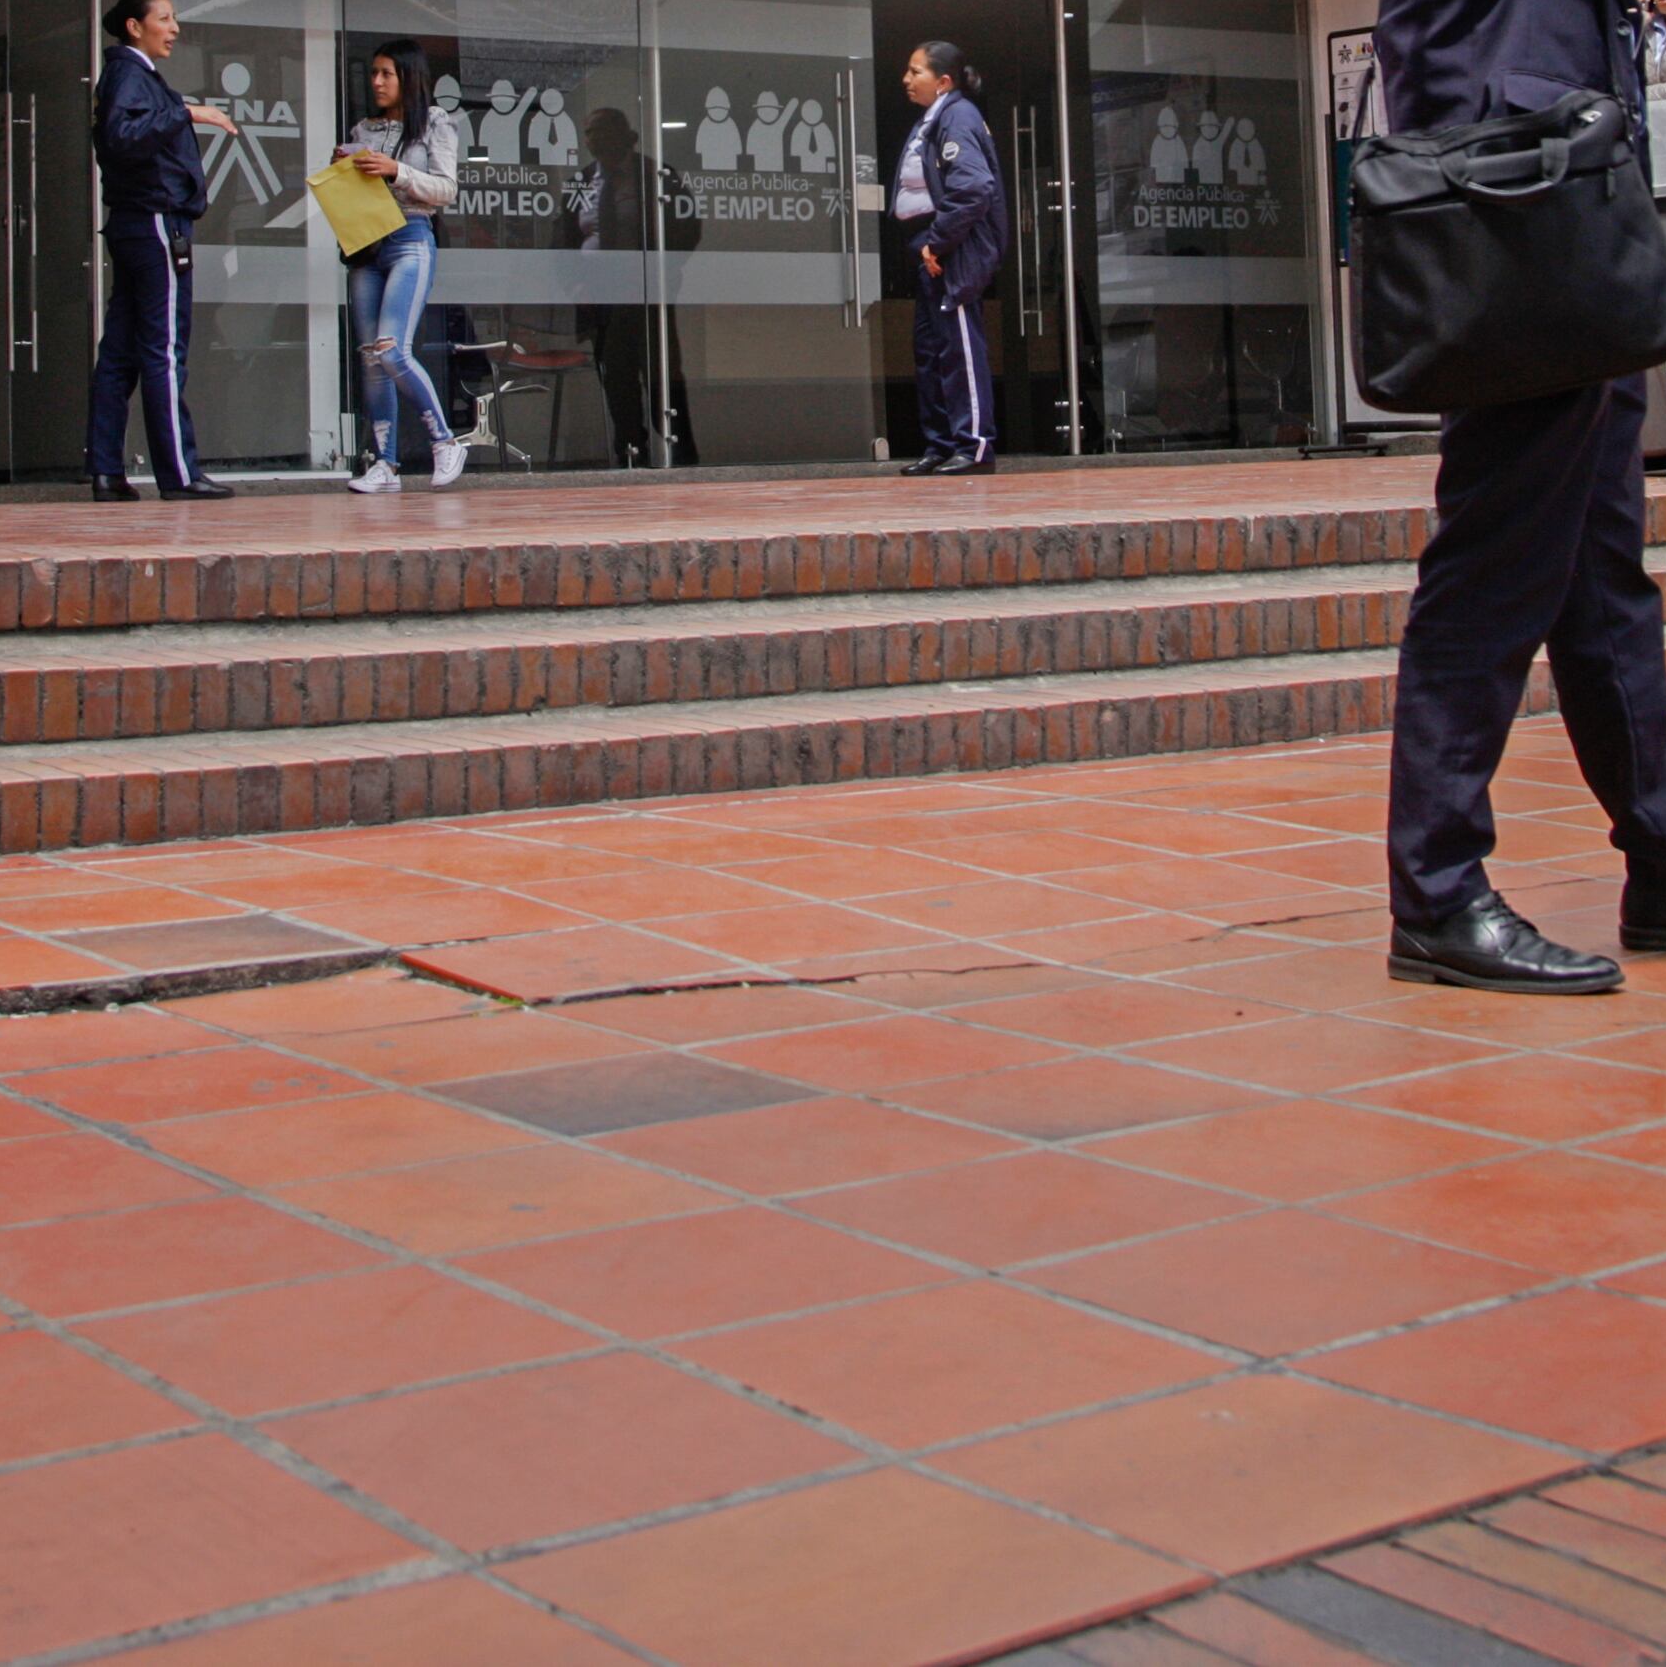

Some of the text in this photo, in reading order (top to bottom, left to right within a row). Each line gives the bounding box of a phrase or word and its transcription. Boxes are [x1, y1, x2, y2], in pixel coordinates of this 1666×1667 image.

[485, 166, 548, 186] Pública
[675, 195, 815, 222] DE EMPLEO
[1134, 205, 1250, 229] DE EMPLEO
